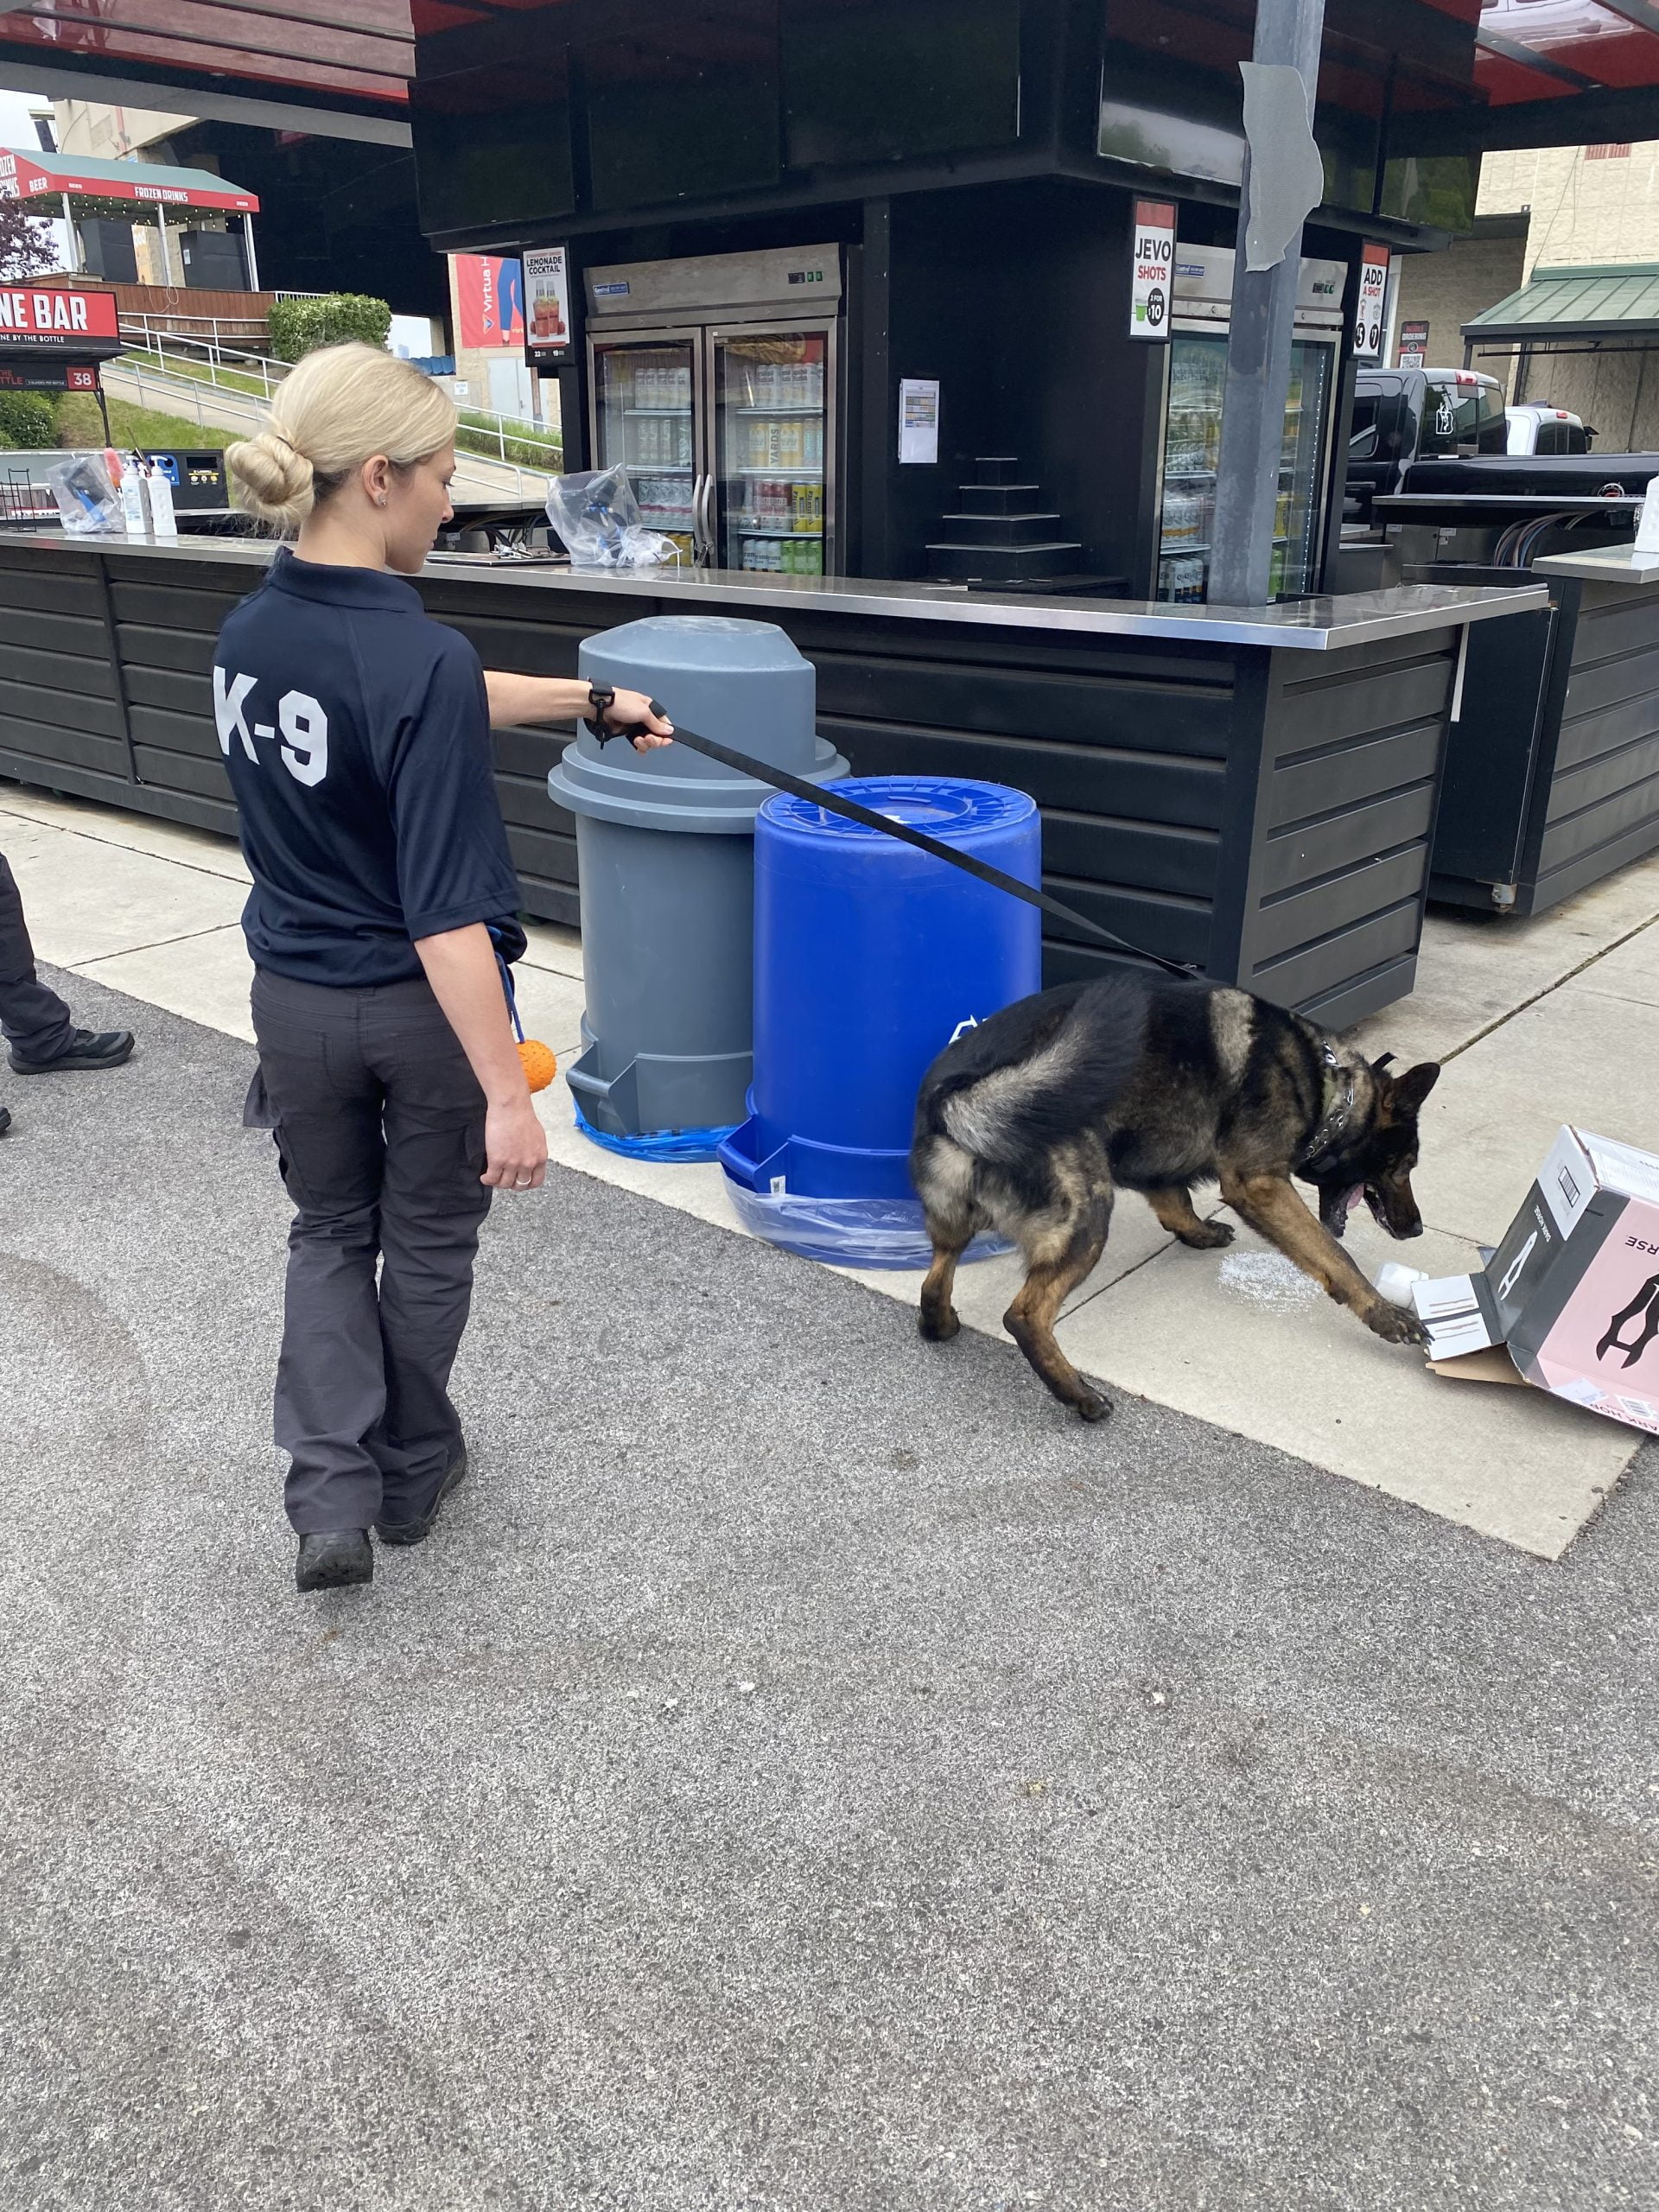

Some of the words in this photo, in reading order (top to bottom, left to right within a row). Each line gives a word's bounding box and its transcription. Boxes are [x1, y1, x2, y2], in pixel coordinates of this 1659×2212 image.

[29, 176, 48, 192] BEER
[134, 186, 162, 200] FROZEN
[162, 189, 188, 202] DRINKS
[1135, 238, 1172, 261] JEVO
[526, 256, 563, 267] LEMONADE
[529, 264, 561, 275] COCKTAIL
[1137, 265, 1166, 281] SHOTS
[1363, 268, 1382, 286] ADD
[1363, 286, 1367, 296] A
[1368, 287, 1382, 297] SHOT
[33, 294, 88, 331] BAR
[73, 372, 92, 385] 38
[770, 429, 779, 464] YARDS
[213, 664, 328, 787] K-9
